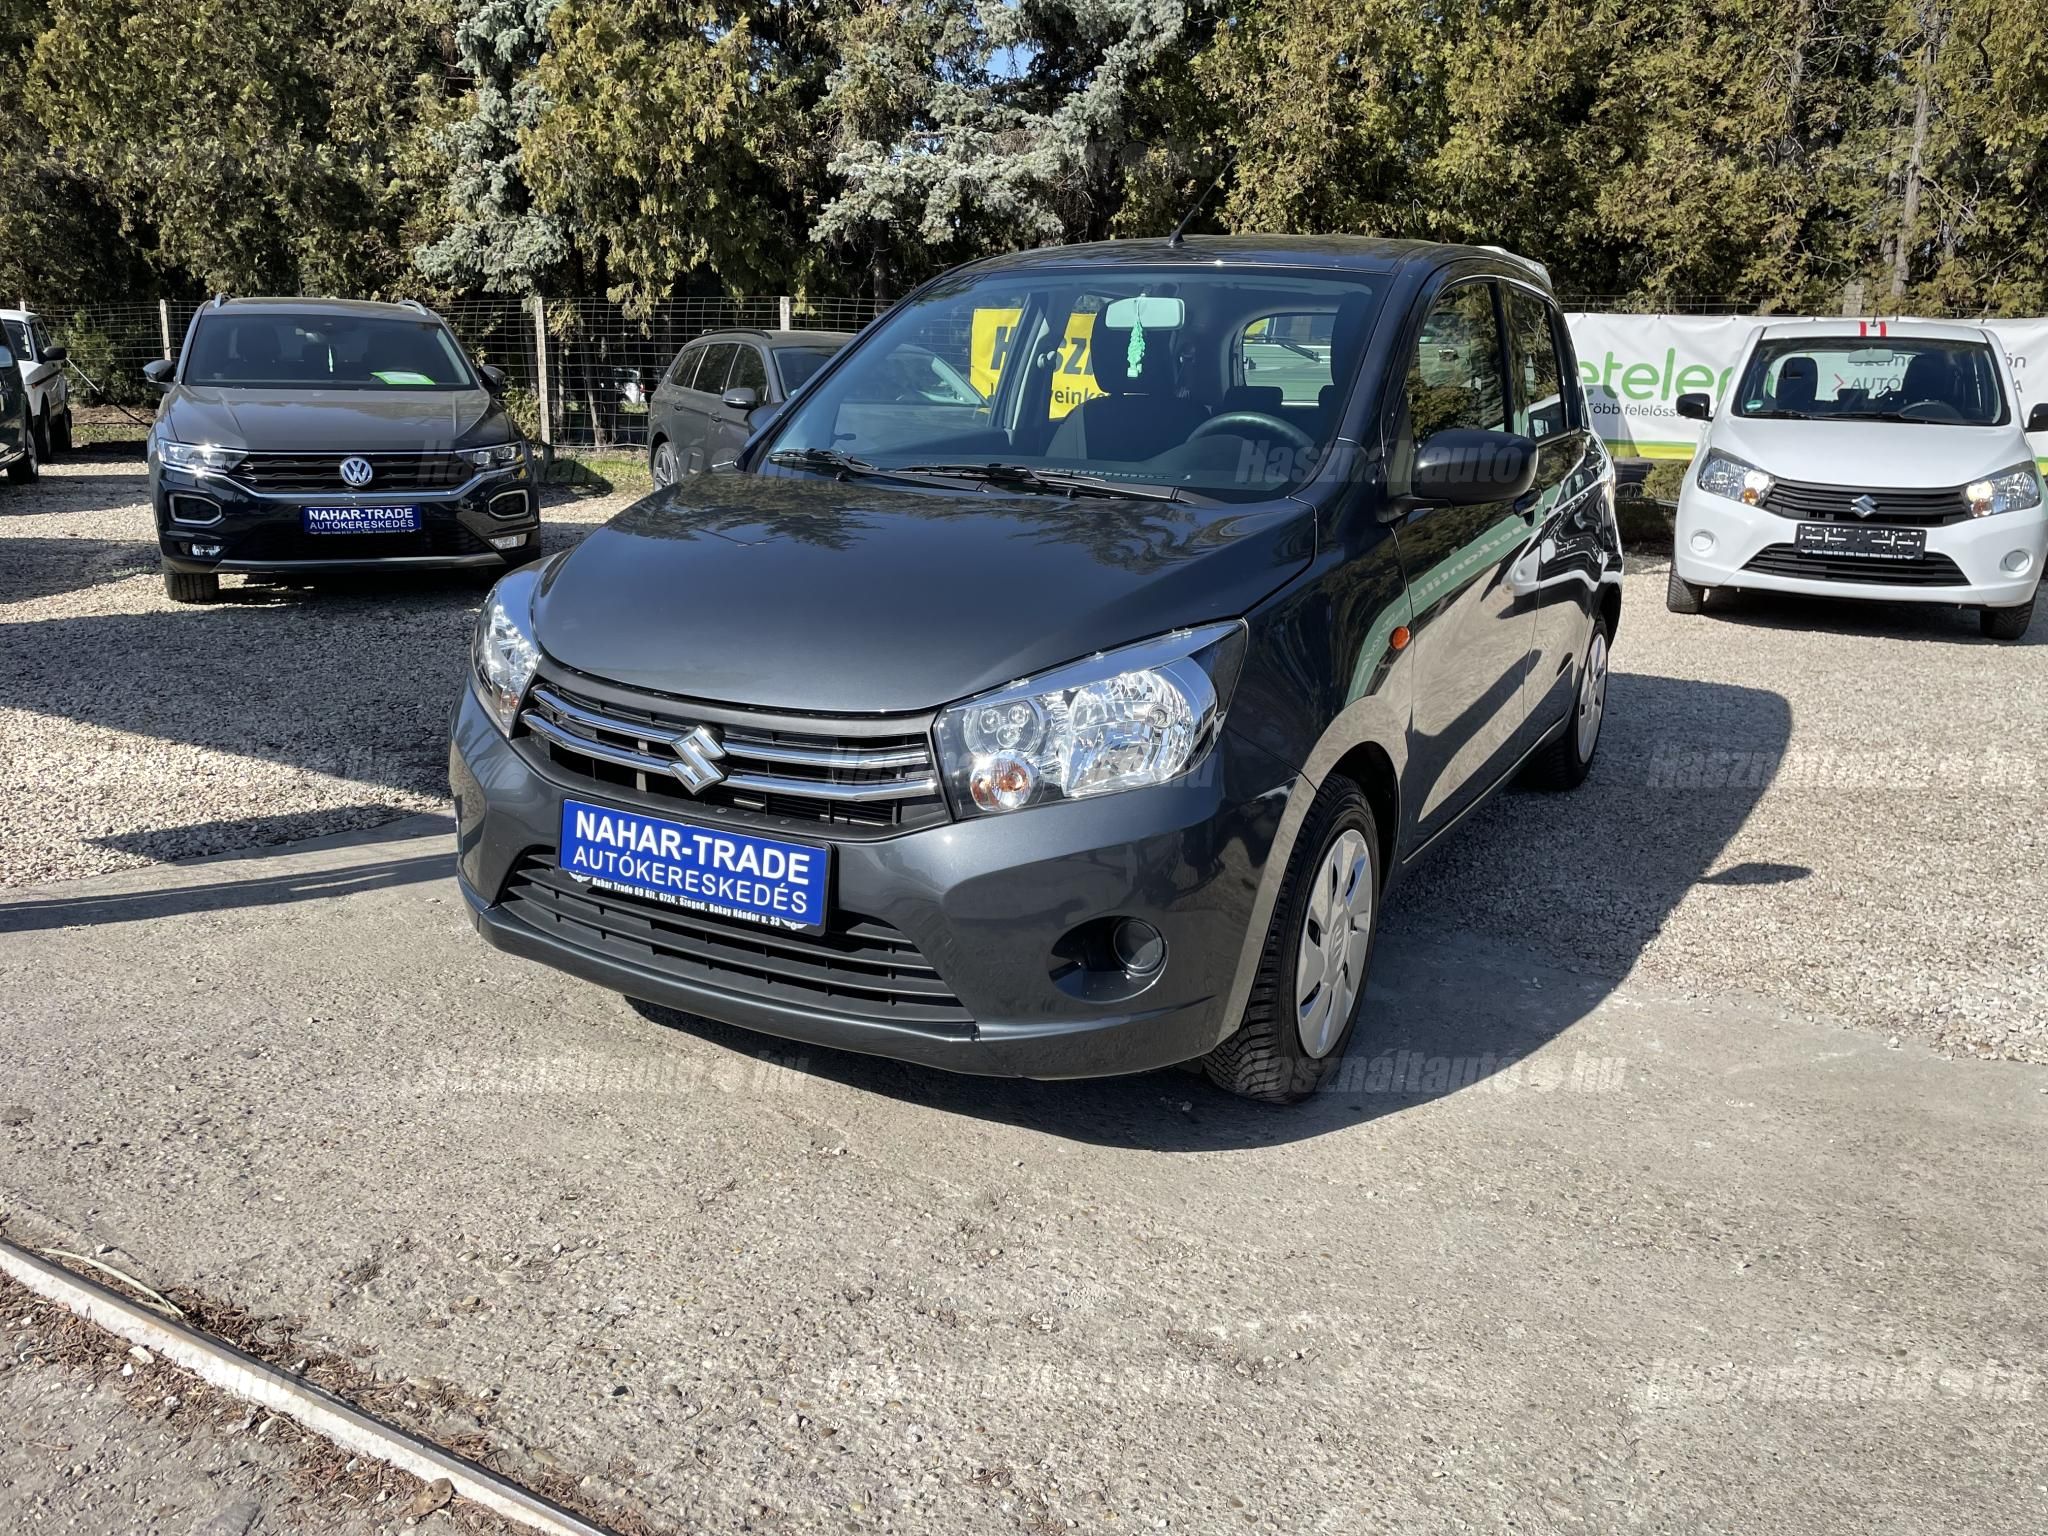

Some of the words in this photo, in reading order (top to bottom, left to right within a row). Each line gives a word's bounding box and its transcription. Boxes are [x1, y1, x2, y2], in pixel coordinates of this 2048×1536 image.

[309, 508, 414, 521] NAHAR-TRADE
[309, 518, 415, 530] AUTÓKERESKEDÉS
[576, 810, 809, 885] NAHAR-TRADE
[573, 846, 808, 914] AUTÓKERESKEDÉS
[770, 916, 780, 927] 33
